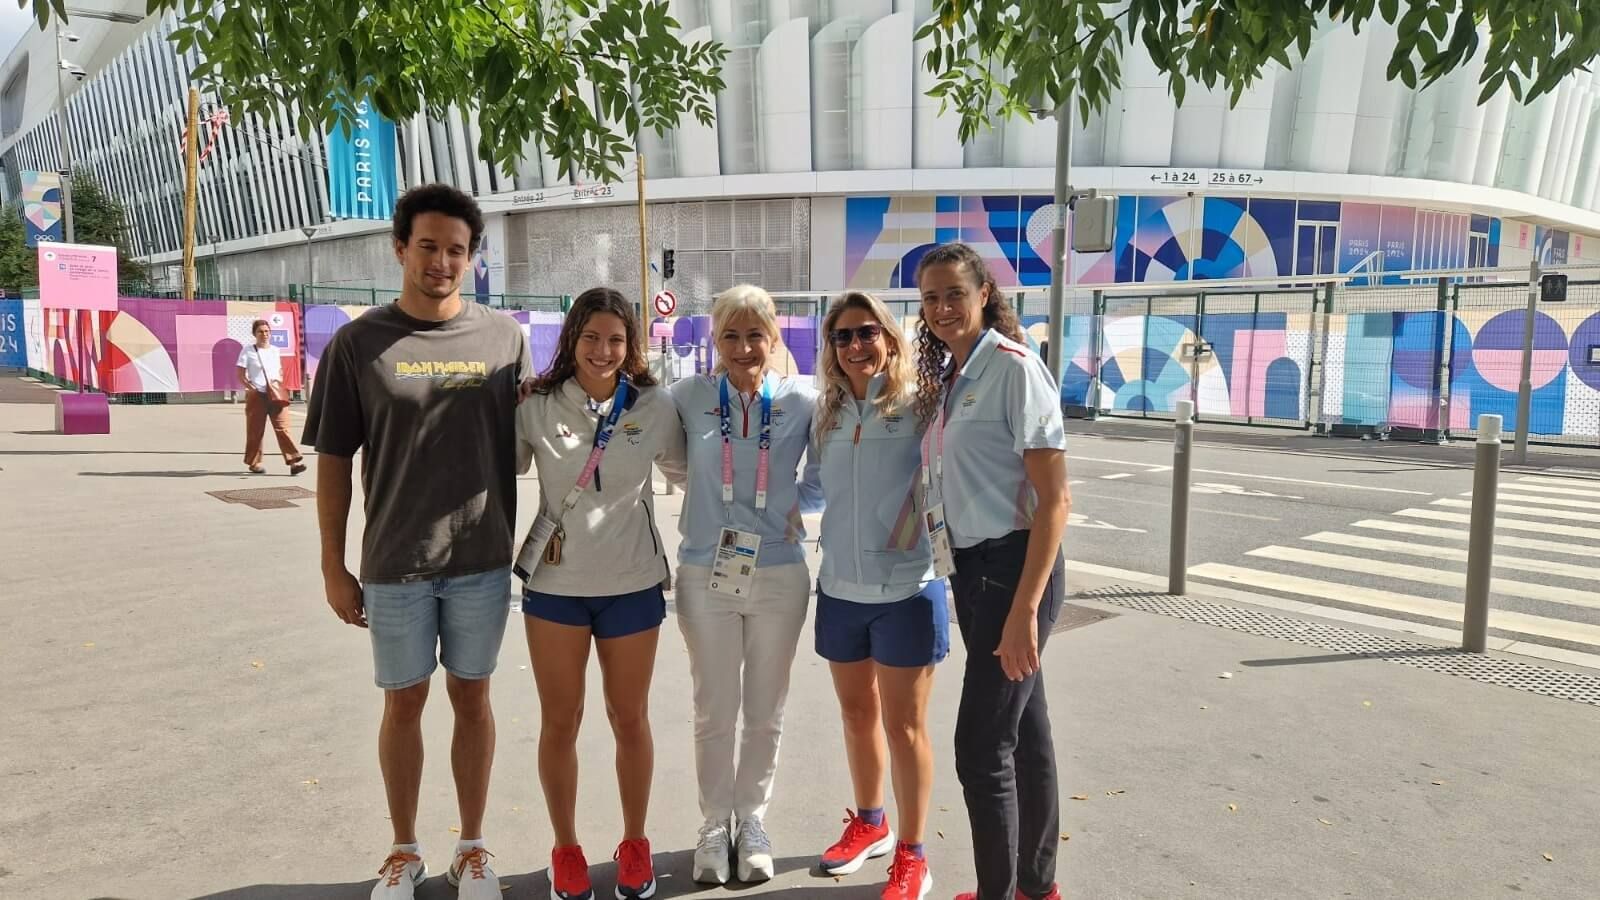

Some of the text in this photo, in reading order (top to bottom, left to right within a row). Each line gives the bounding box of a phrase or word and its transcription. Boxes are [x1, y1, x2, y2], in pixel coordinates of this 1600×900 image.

[1182, 172, 1196, 181] 24
[1212, 172, 1225, 182] 25
[1238, 174, 1252, 183] 67
[601, 186, 612, 195] 23
